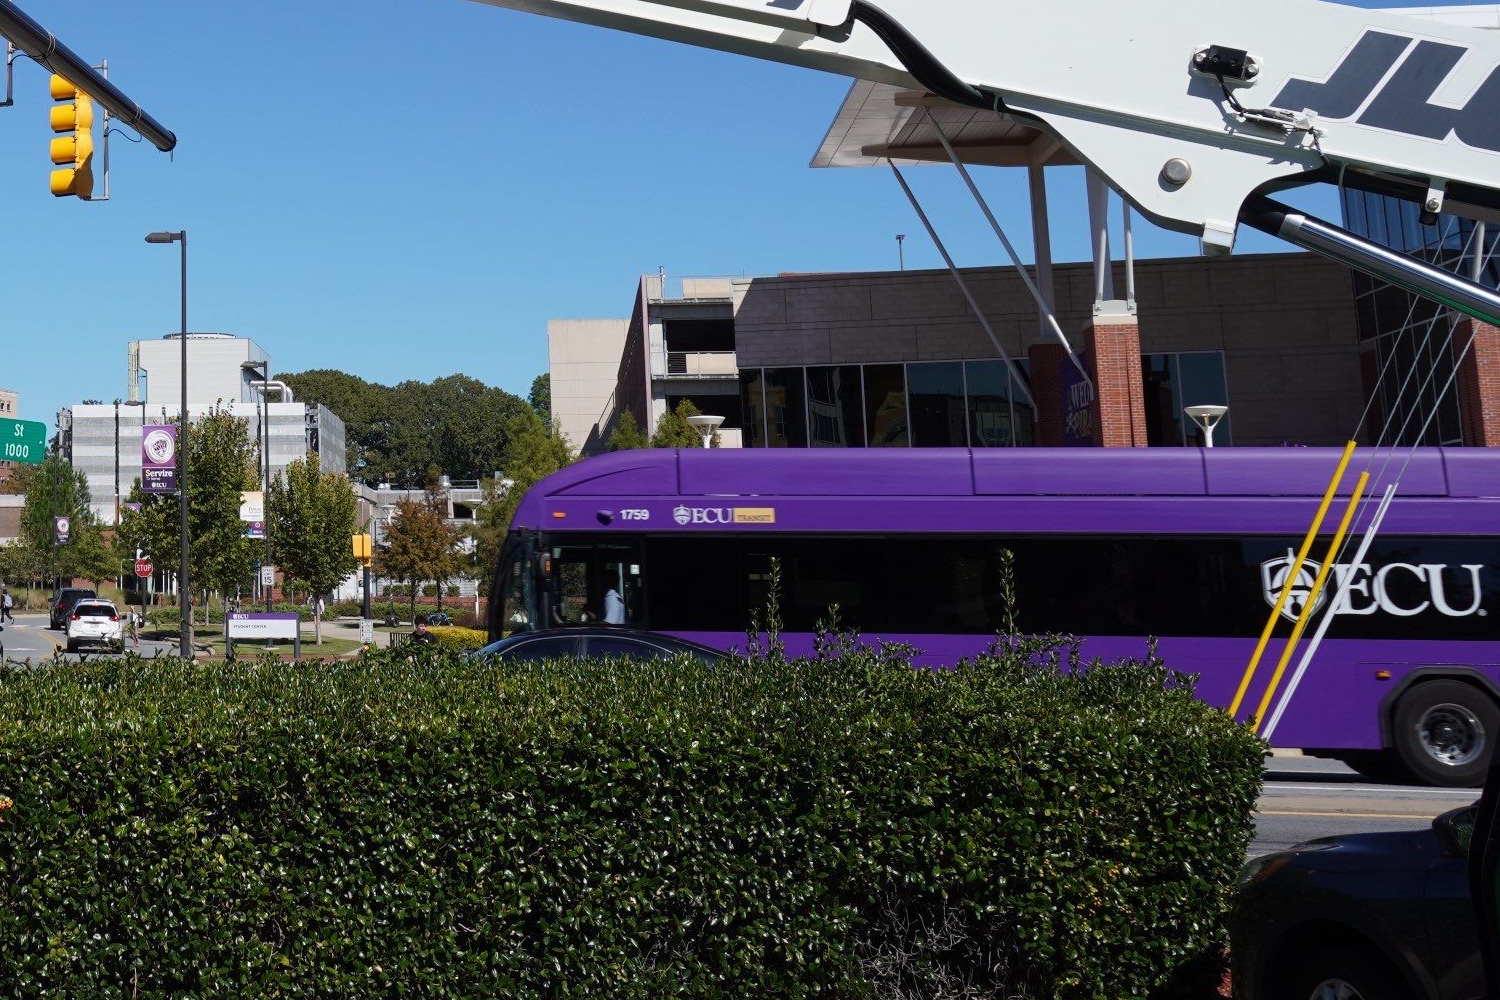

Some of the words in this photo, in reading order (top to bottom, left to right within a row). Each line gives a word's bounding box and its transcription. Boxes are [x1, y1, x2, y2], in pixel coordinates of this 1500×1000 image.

[14, 424, 25, 437] St
[5, 443, 29, 458] 1000
[145, 469, 173, 477] Servire
[620, 509, 650, 521] 1759
[691, 507, 733, 524] ECU
[136, 564, 152, 572] STOP
[264, 576, 273, 584] 15
[1329, 563, 1485, 616] ECU
